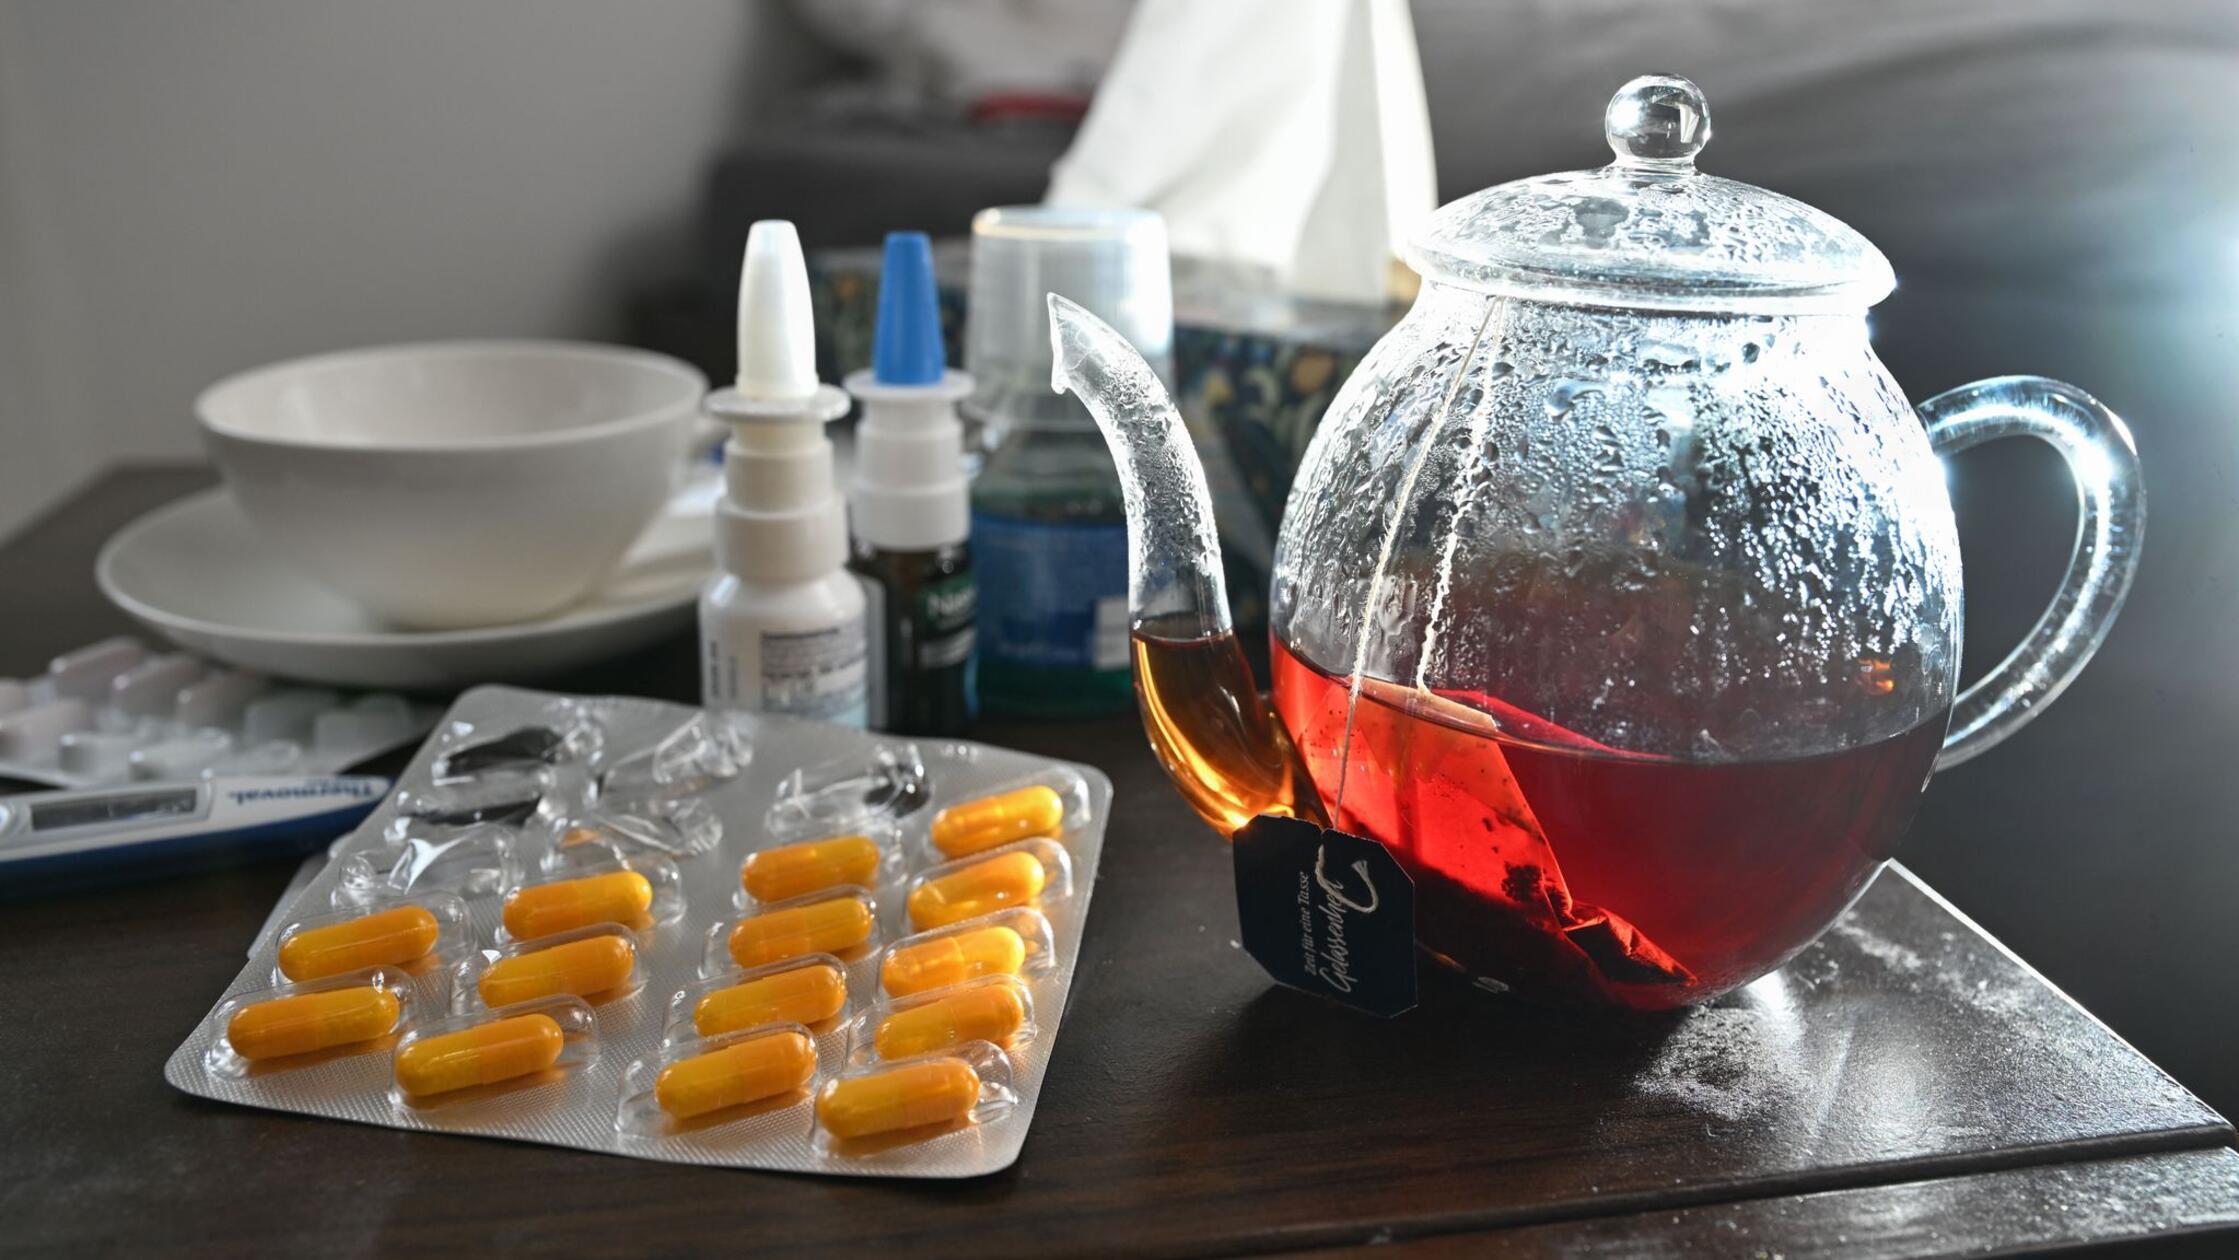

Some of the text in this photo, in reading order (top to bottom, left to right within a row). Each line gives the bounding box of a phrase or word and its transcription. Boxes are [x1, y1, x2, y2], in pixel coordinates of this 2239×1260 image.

[236, 783, 372, 804] Thermoval
[1297, 871, 1317, 976] Zeit für eine Tasse
[1318, 880, 1358, 992] Gelassenhet
